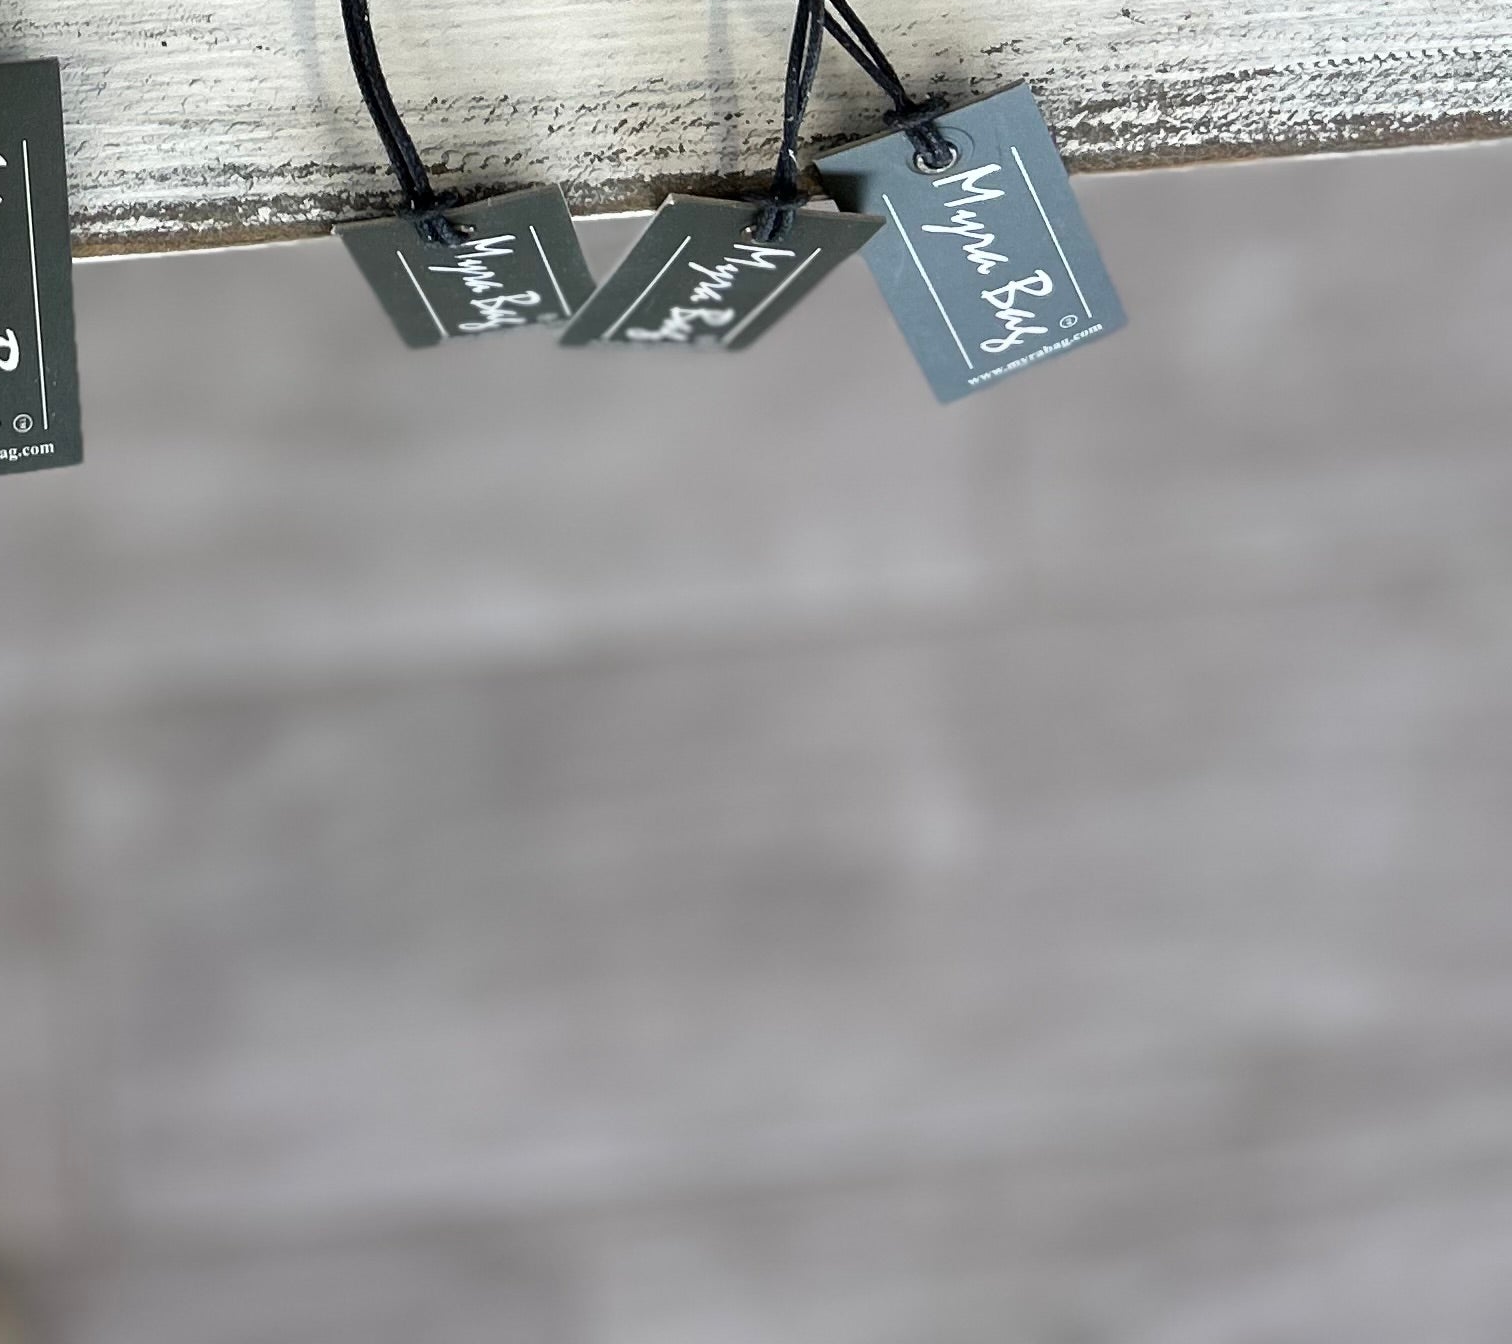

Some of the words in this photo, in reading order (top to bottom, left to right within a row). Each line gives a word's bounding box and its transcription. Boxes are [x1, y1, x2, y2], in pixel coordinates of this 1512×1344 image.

[427, 234, 517, 294] Myra
[688, 243, 796, 302] Myra
[921, 163, 1010, 275] Myra
[980, 269, 1053, 353] Bag
[458, 290, 542, 331] Bag
